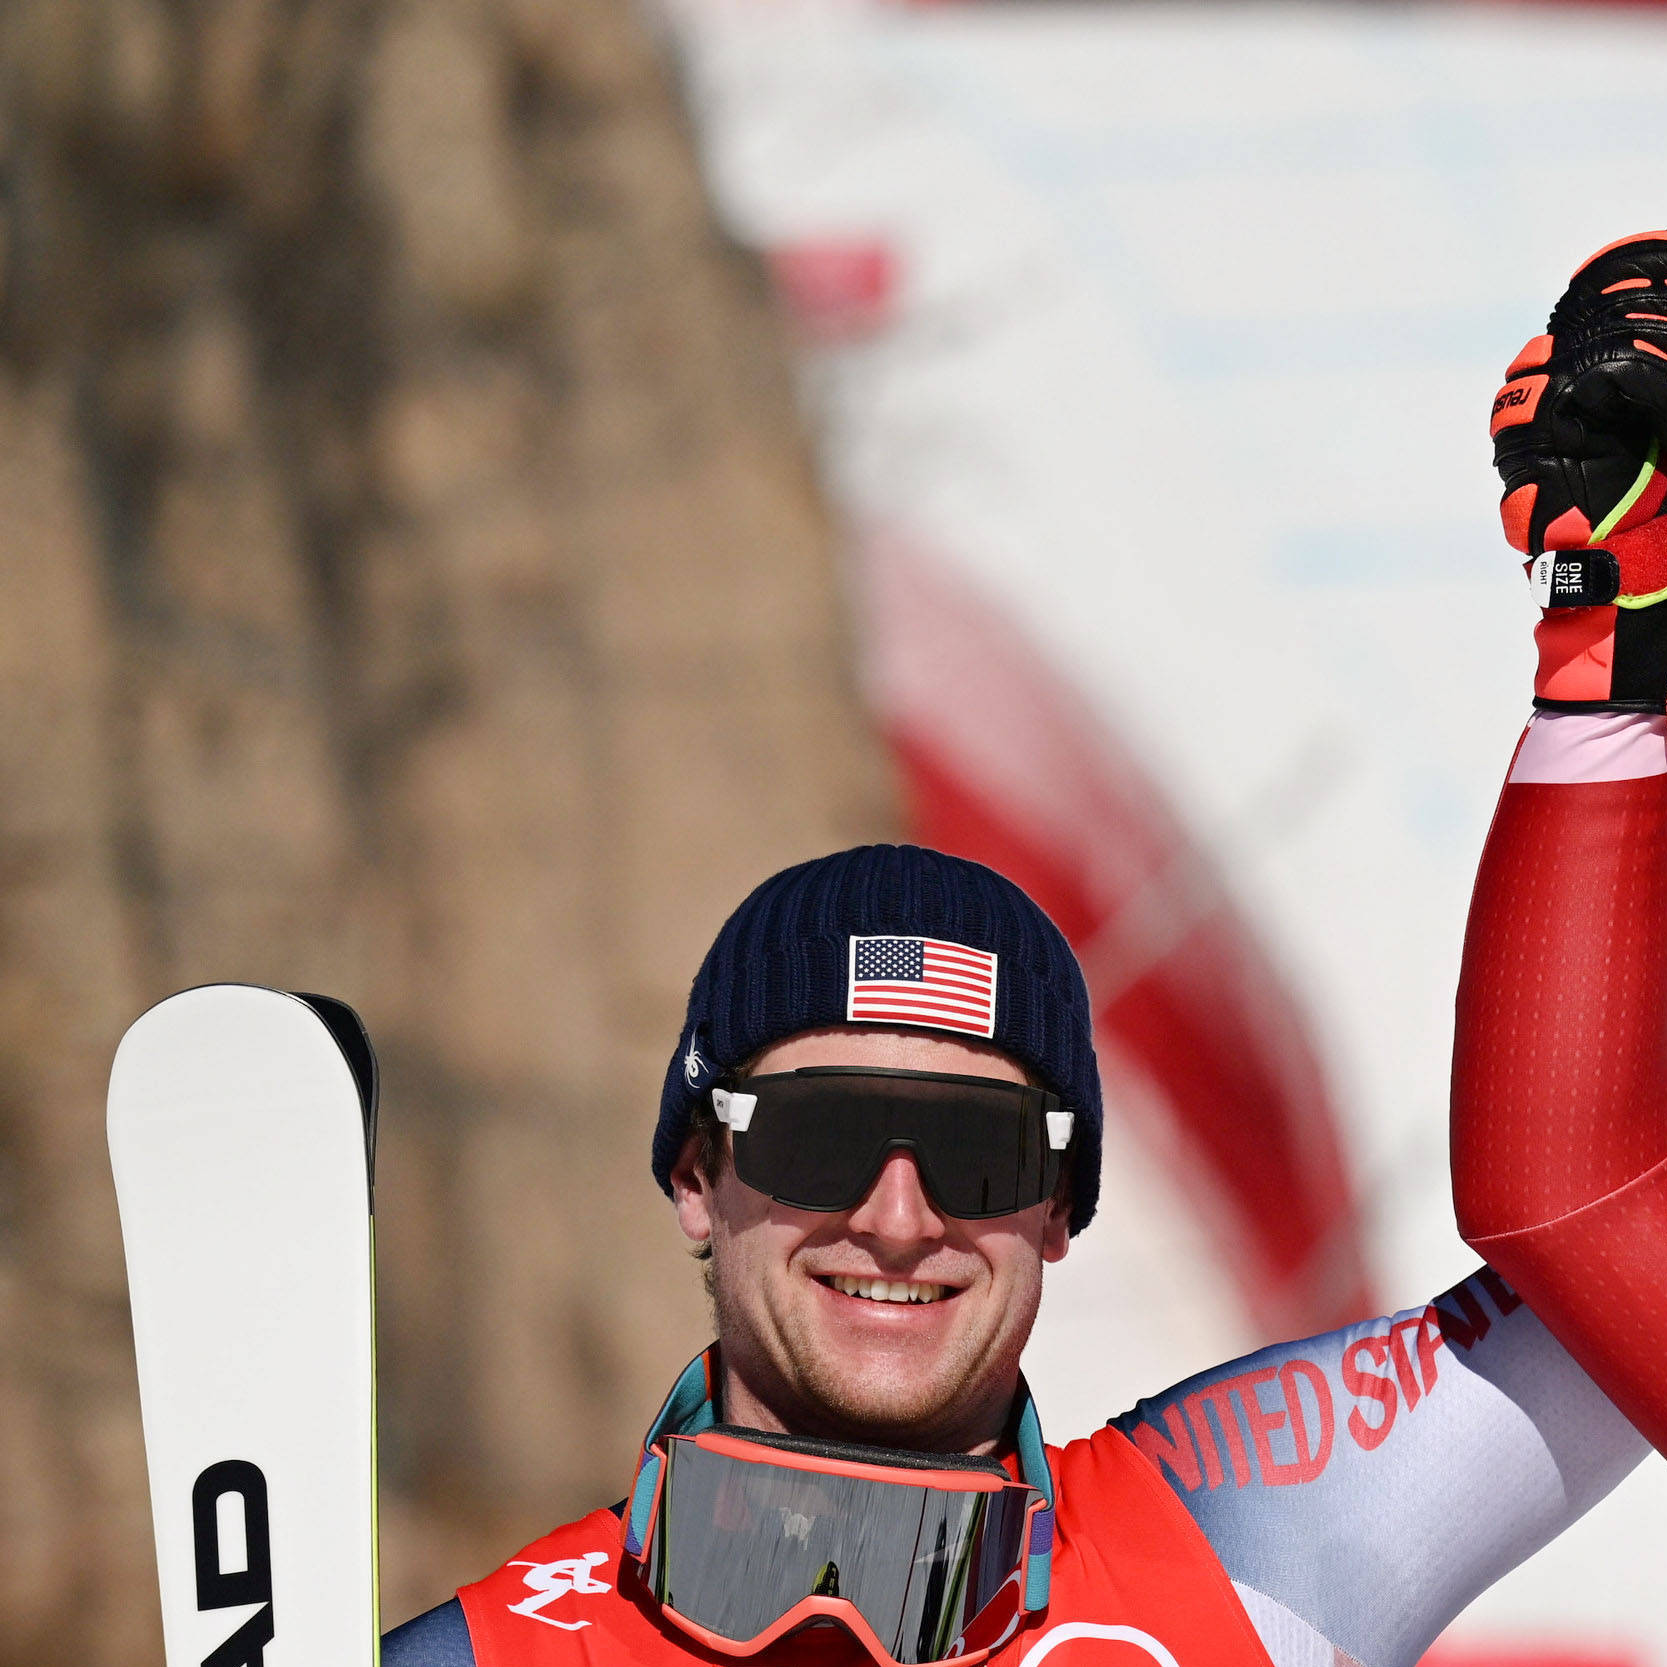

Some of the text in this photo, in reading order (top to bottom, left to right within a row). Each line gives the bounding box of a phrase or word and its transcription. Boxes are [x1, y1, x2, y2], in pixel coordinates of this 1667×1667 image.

[1539, 561, 1547, 586] RIGHT
[1555, 563, 1569, 594] SIZE
[1568, 562, 1583, 594] ONE
[1133, 1360, 1334, 1494] NITED
